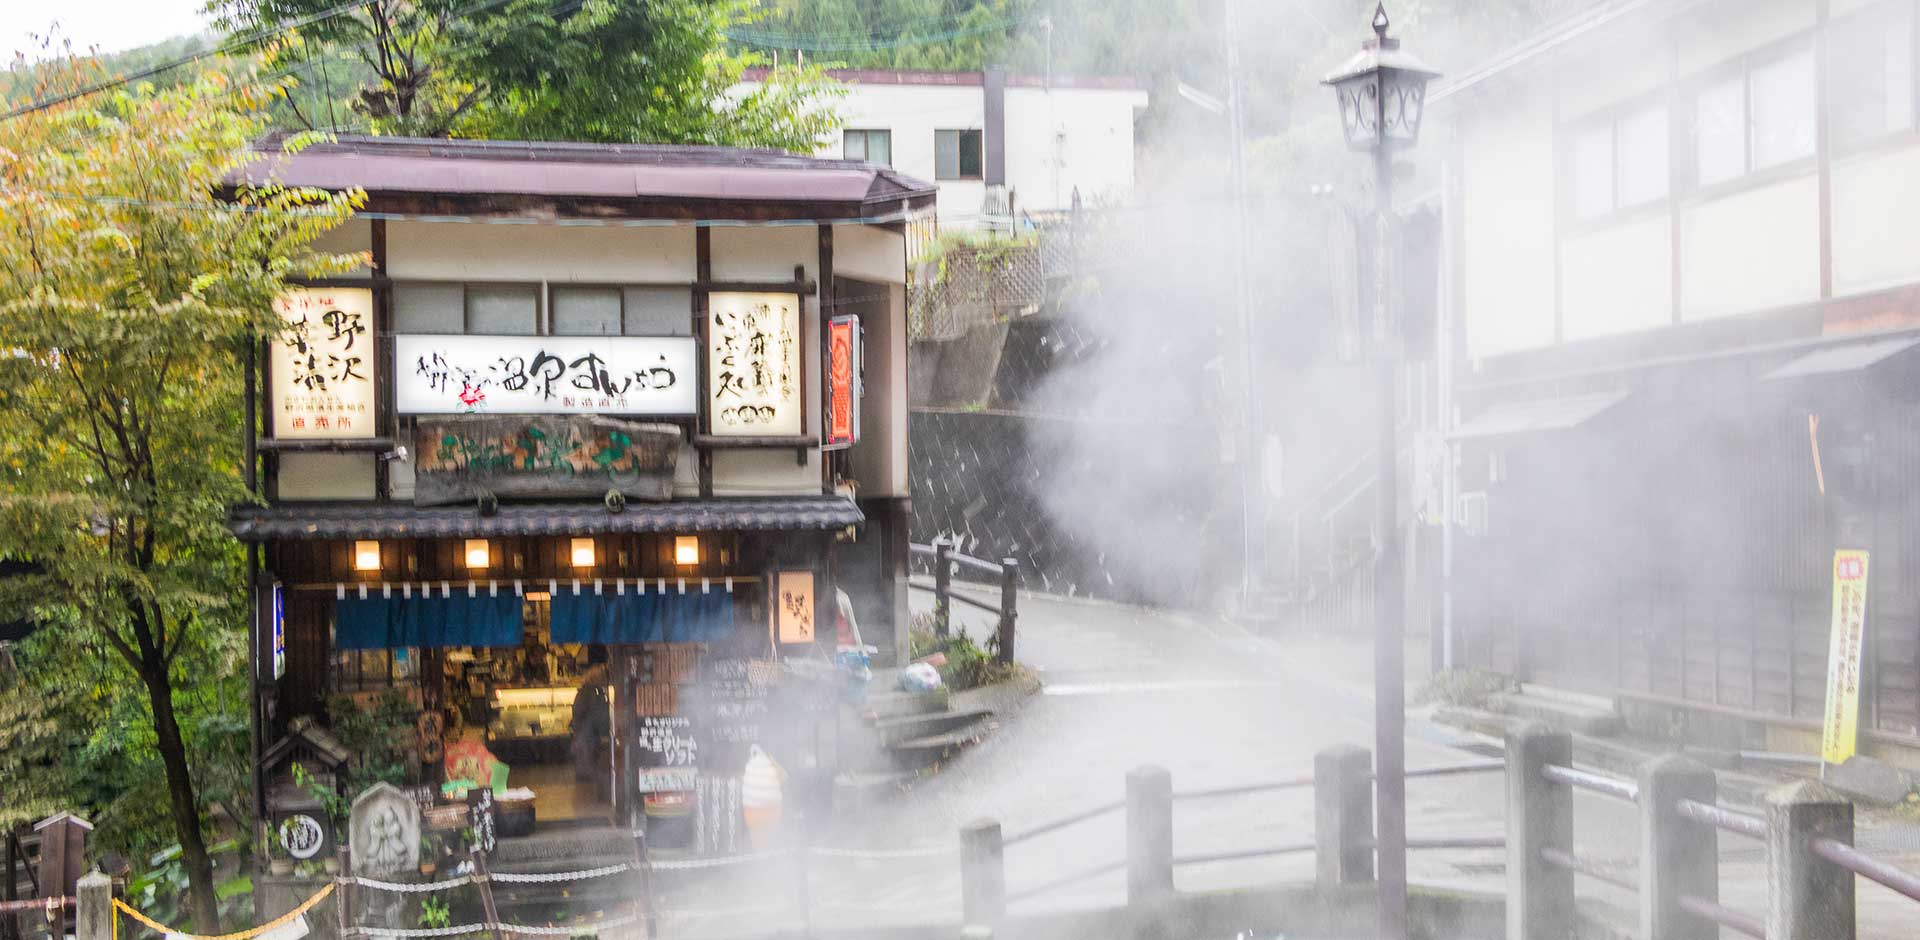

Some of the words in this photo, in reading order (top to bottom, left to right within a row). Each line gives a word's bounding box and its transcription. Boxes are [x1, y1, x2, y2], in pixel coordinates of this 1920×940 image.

[322, 310, 369, 384] 野沢
[291, 416, 352, 433] 直売所
